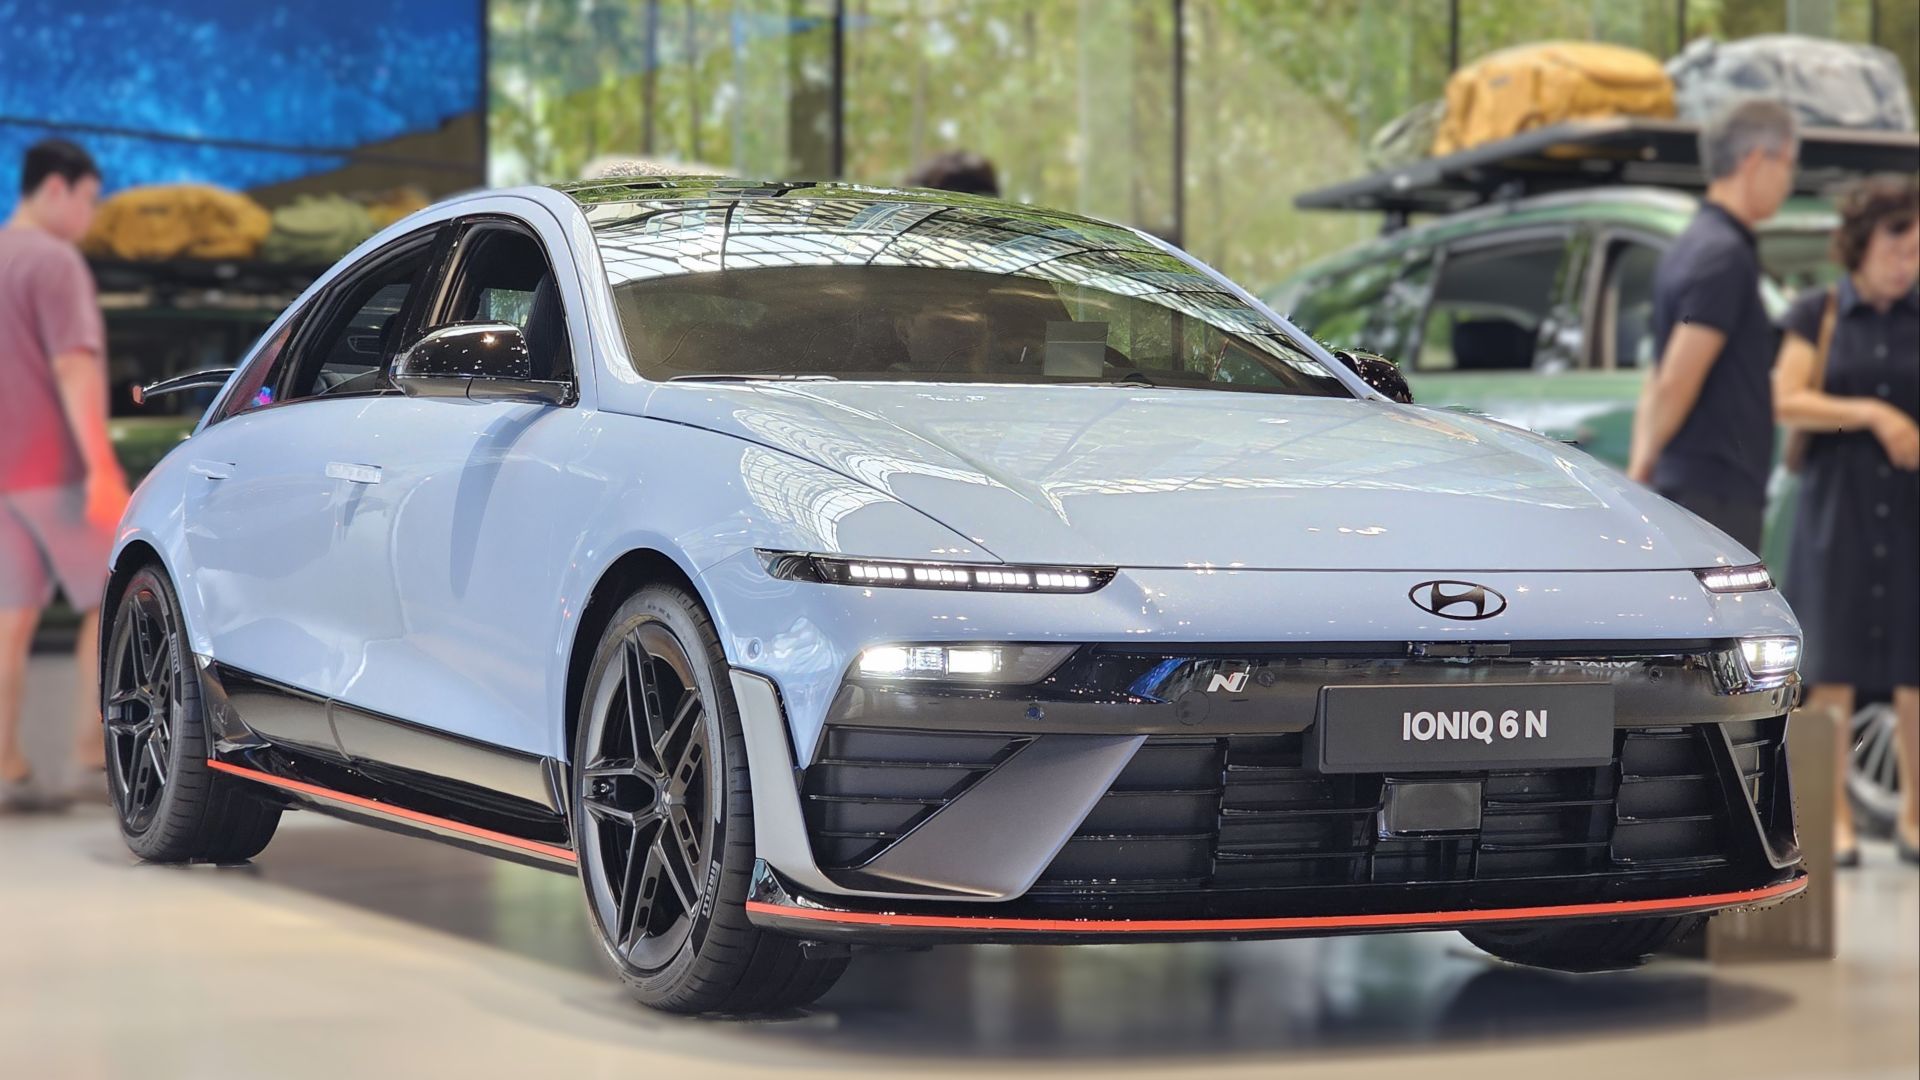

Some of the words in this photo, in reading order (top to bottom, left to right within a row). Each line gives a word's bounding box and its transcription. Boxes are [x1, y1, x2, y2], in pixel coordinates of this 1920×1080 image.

[1403, 711, 1494, 744] IONIQ
[1500, 709, 1519, 739] 6
[1525, 710, 1548, 738] N
[701, 860, 721, 919] PIRELLI
